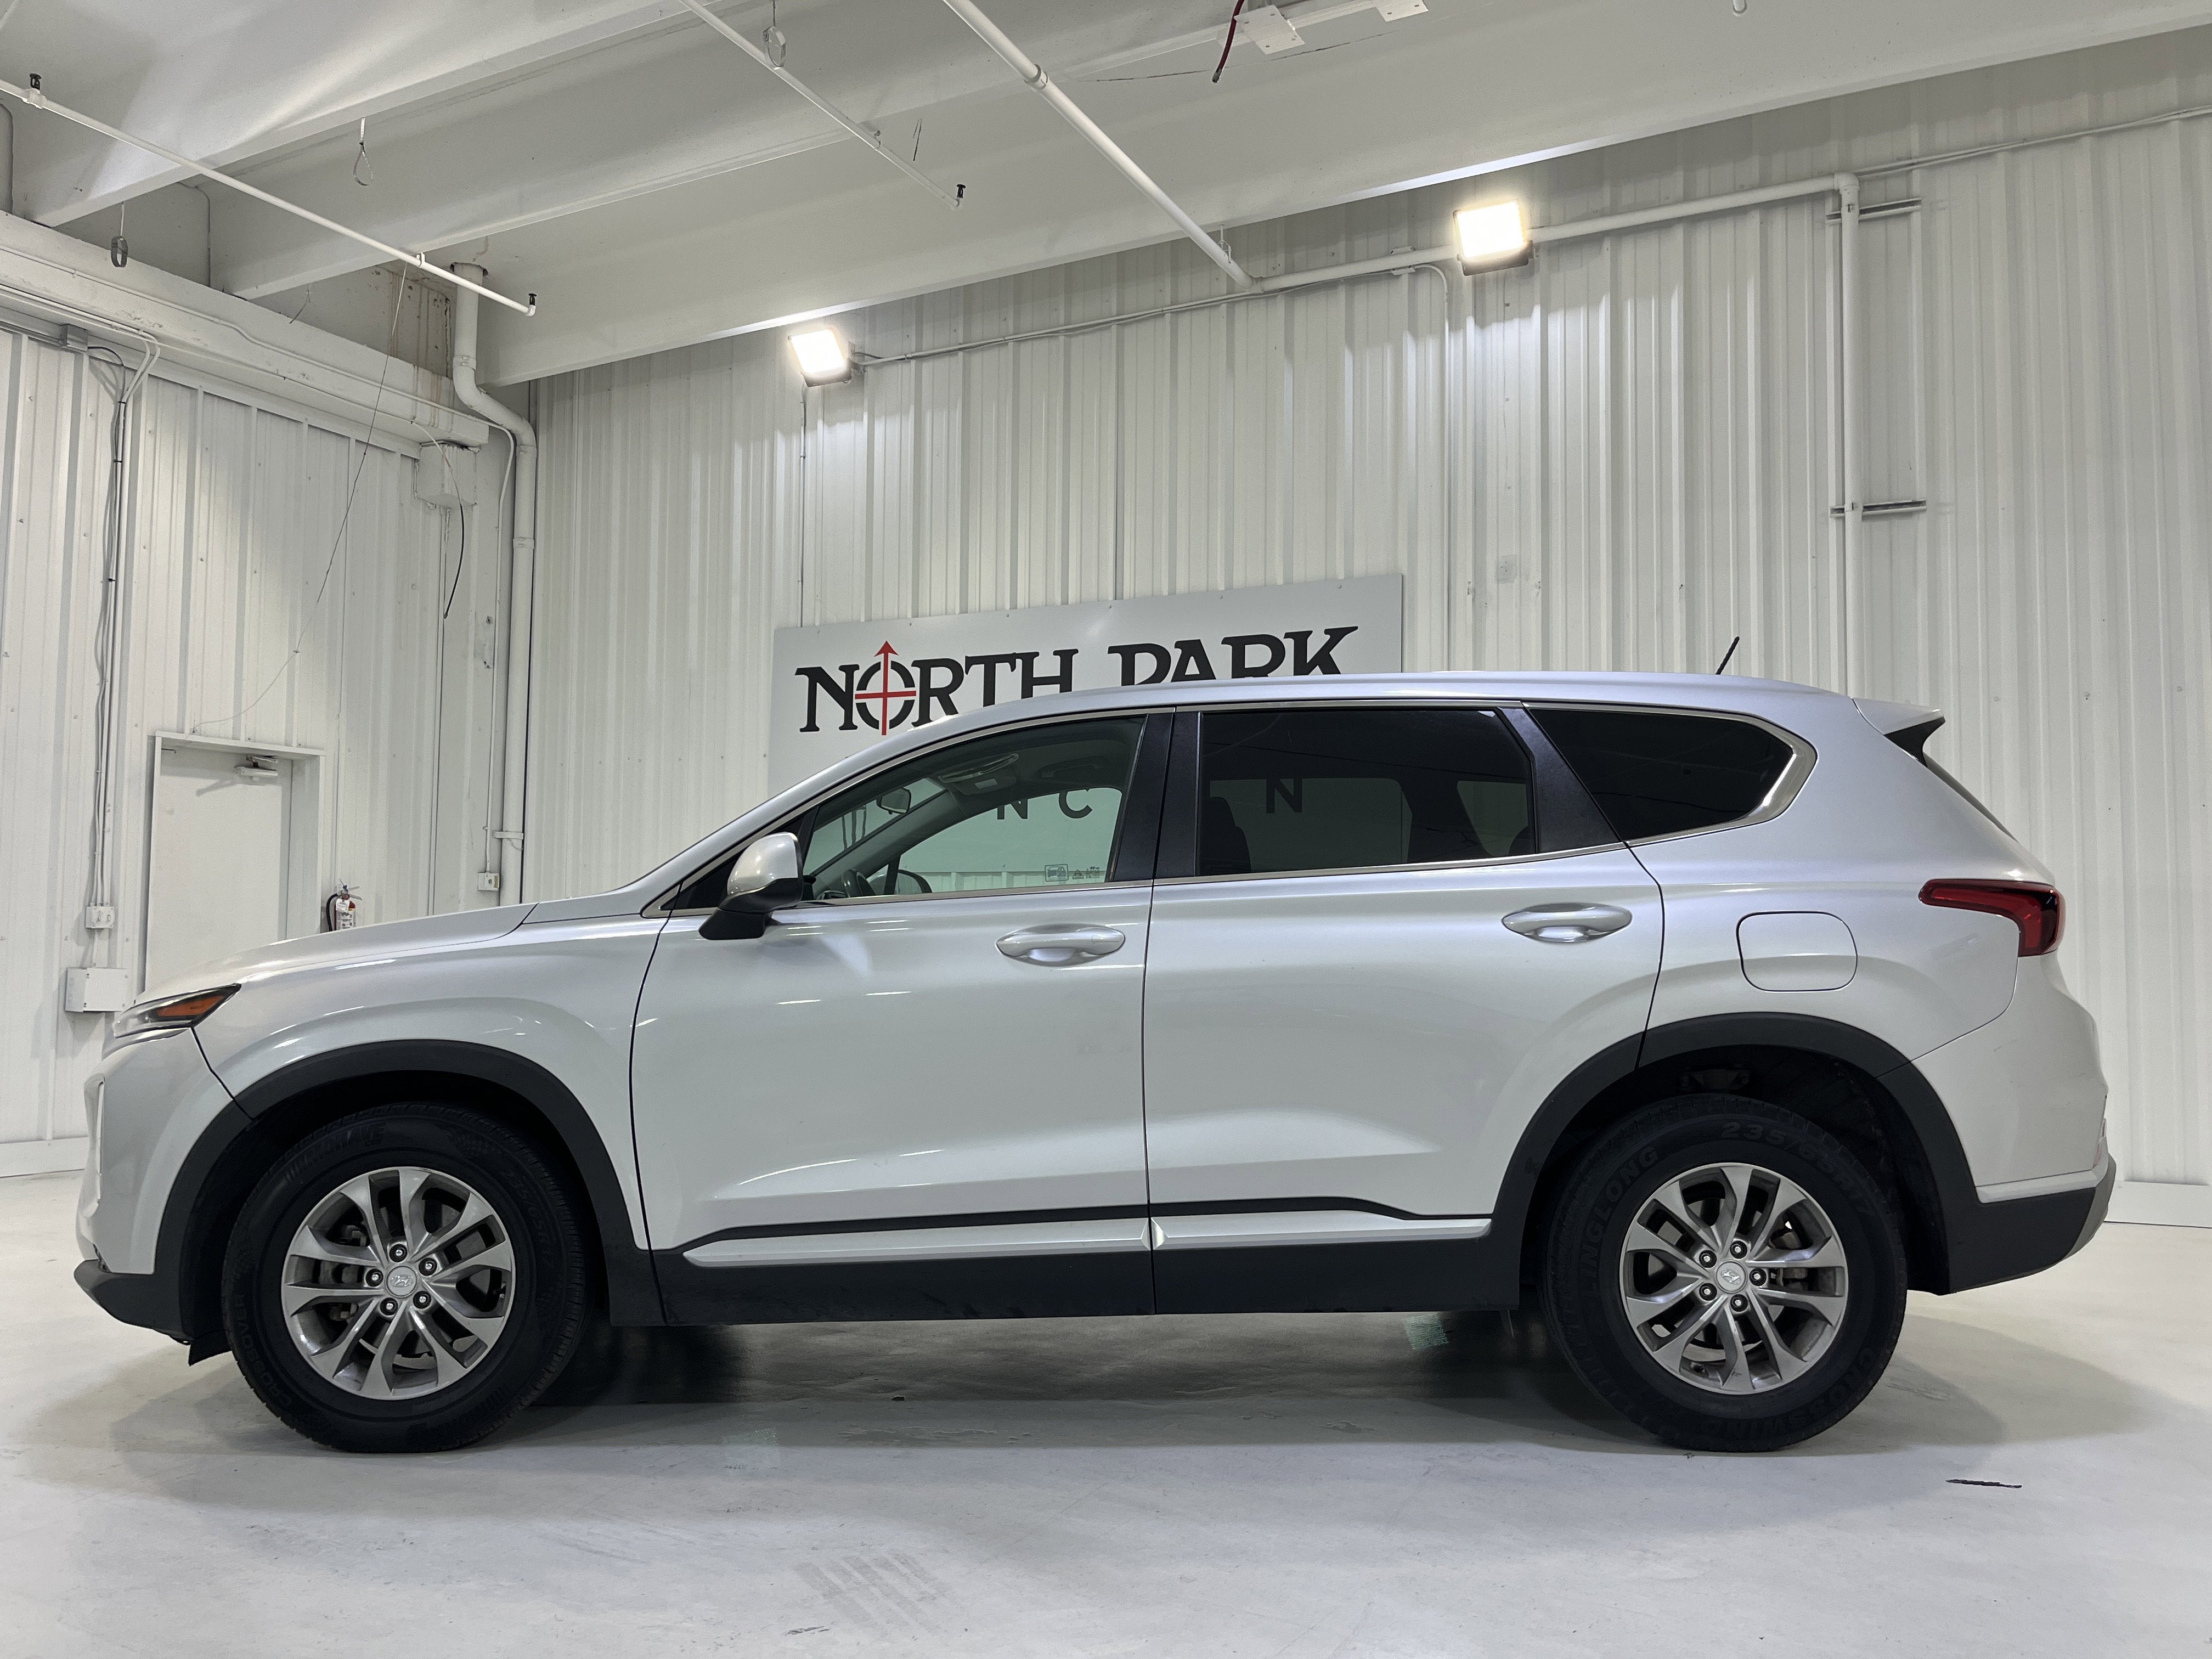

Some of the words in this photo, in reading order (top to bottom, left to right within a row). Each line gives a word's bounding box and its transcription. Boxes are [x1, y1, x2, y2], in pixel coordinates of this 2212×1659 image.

[794, 648, 1079, 732] NORTH
[1108, 626, 1358, 686] PARK
[1266, 779, 1302, 813] N
[498, 1168, 555, 1270] 235/65R17
[1720, 1121, 1877, 1216] 235/65R17
[1580, 1145, 1659, 1295] LINGLONG
[234, 1294, 292, 1409] CROSSOVER
[1700, 1347, 1876, 1441] CROSSWIND
